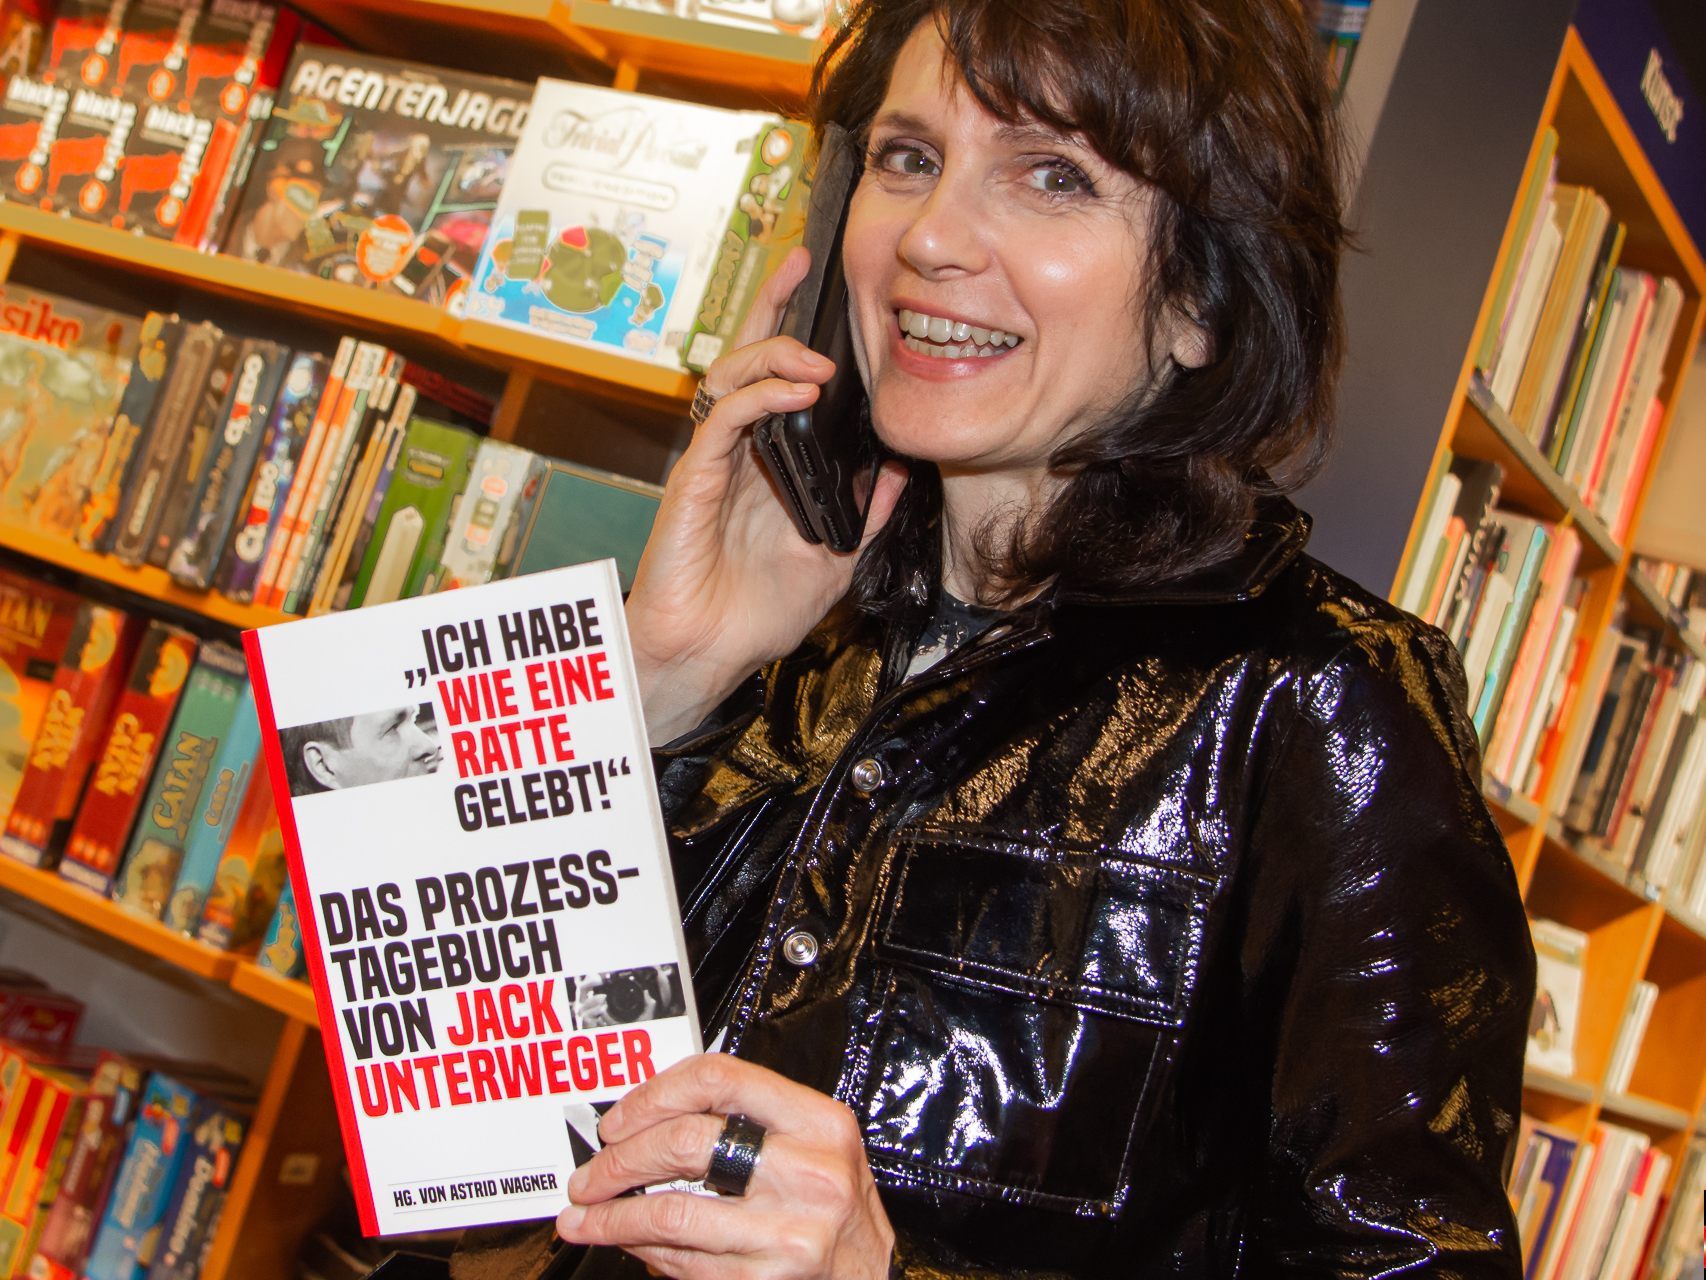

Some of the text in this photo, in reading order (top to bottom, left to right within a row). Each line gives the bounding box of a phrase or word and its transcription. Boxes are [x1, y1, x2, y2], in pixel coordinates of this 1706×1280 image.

[0, 288, 81, 349] siko
[498, 598, 604, 662] HABE
[437, 652, 615, 726] WIE EINE
[152, 731, 206, 830] CATAN
[451, 714, 574, 778] RATTE
[319, 882, 408, 946] DAS
[416, 849, 639, 930] PROZESS-
[330, 919, 563, 1003] TAGEBUCH
[342, 980, 564, 1060] VON JACK
[355, 1029, 656, 1118] UNTERWEGER
[393, 1172, 558, 1208] HG. VON ASTRID WAGNER
[669, 1181, 704, 1193] Seifer
